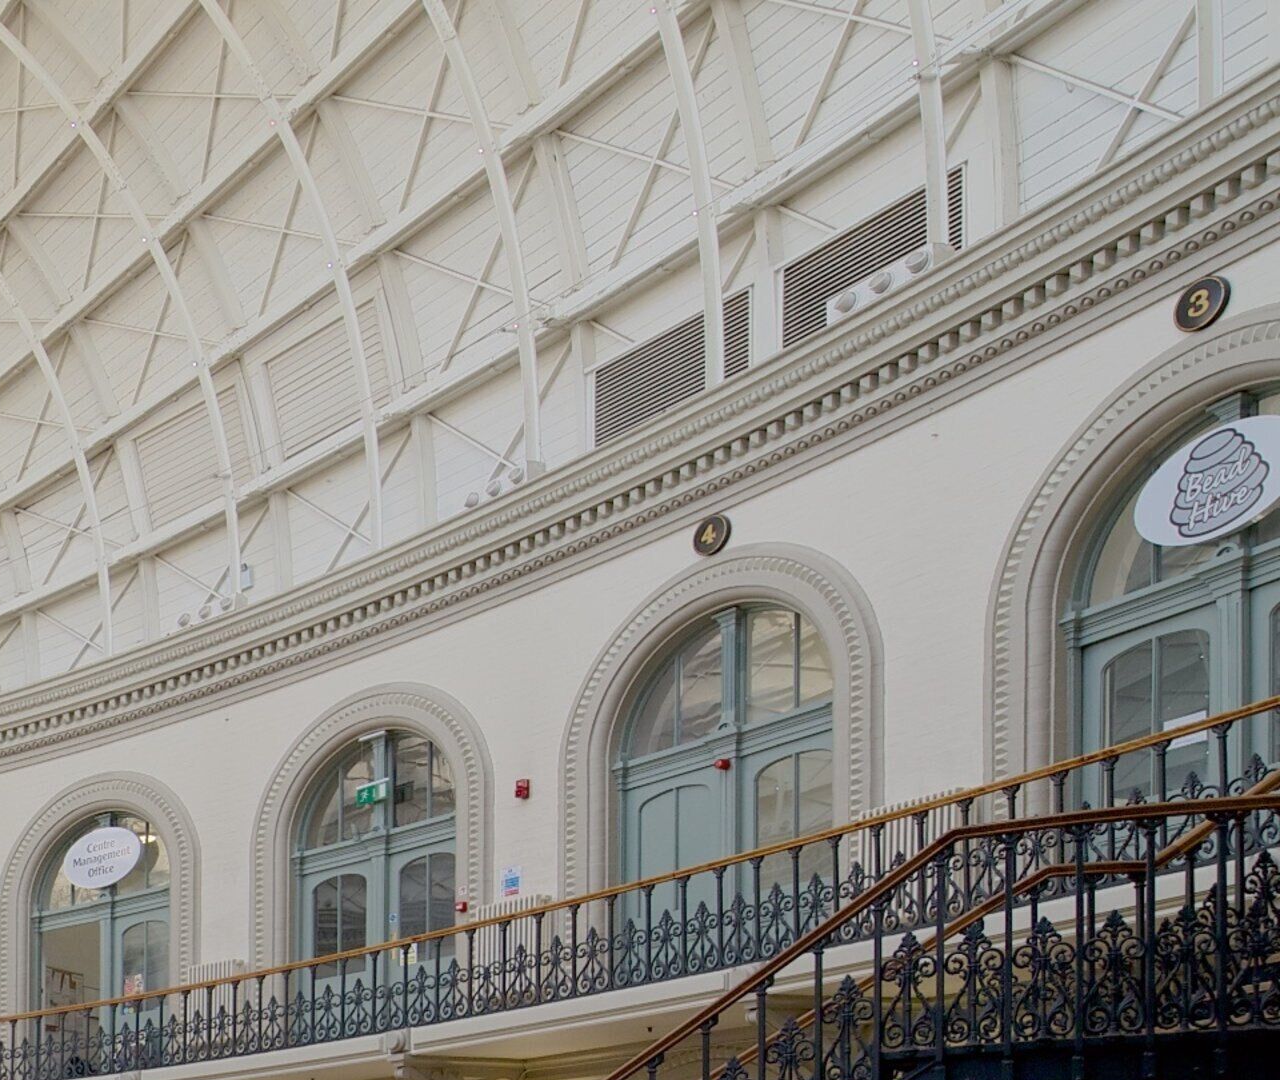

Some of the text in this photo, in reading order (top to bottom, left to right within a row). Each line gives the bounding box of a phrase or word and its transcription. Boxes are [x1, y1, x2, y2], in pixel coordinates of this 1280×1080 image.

[1187, 288, 1210, 318] 3
[1184, 447, 1252, 502] Bead
[1187, 483, 1252, 531] Hive
[700, 523, 717, 545] 4
[72, 846, 132, 868] Management
[86, 839, 115, 854] Centre
[87, 864, 115, 878] Office
